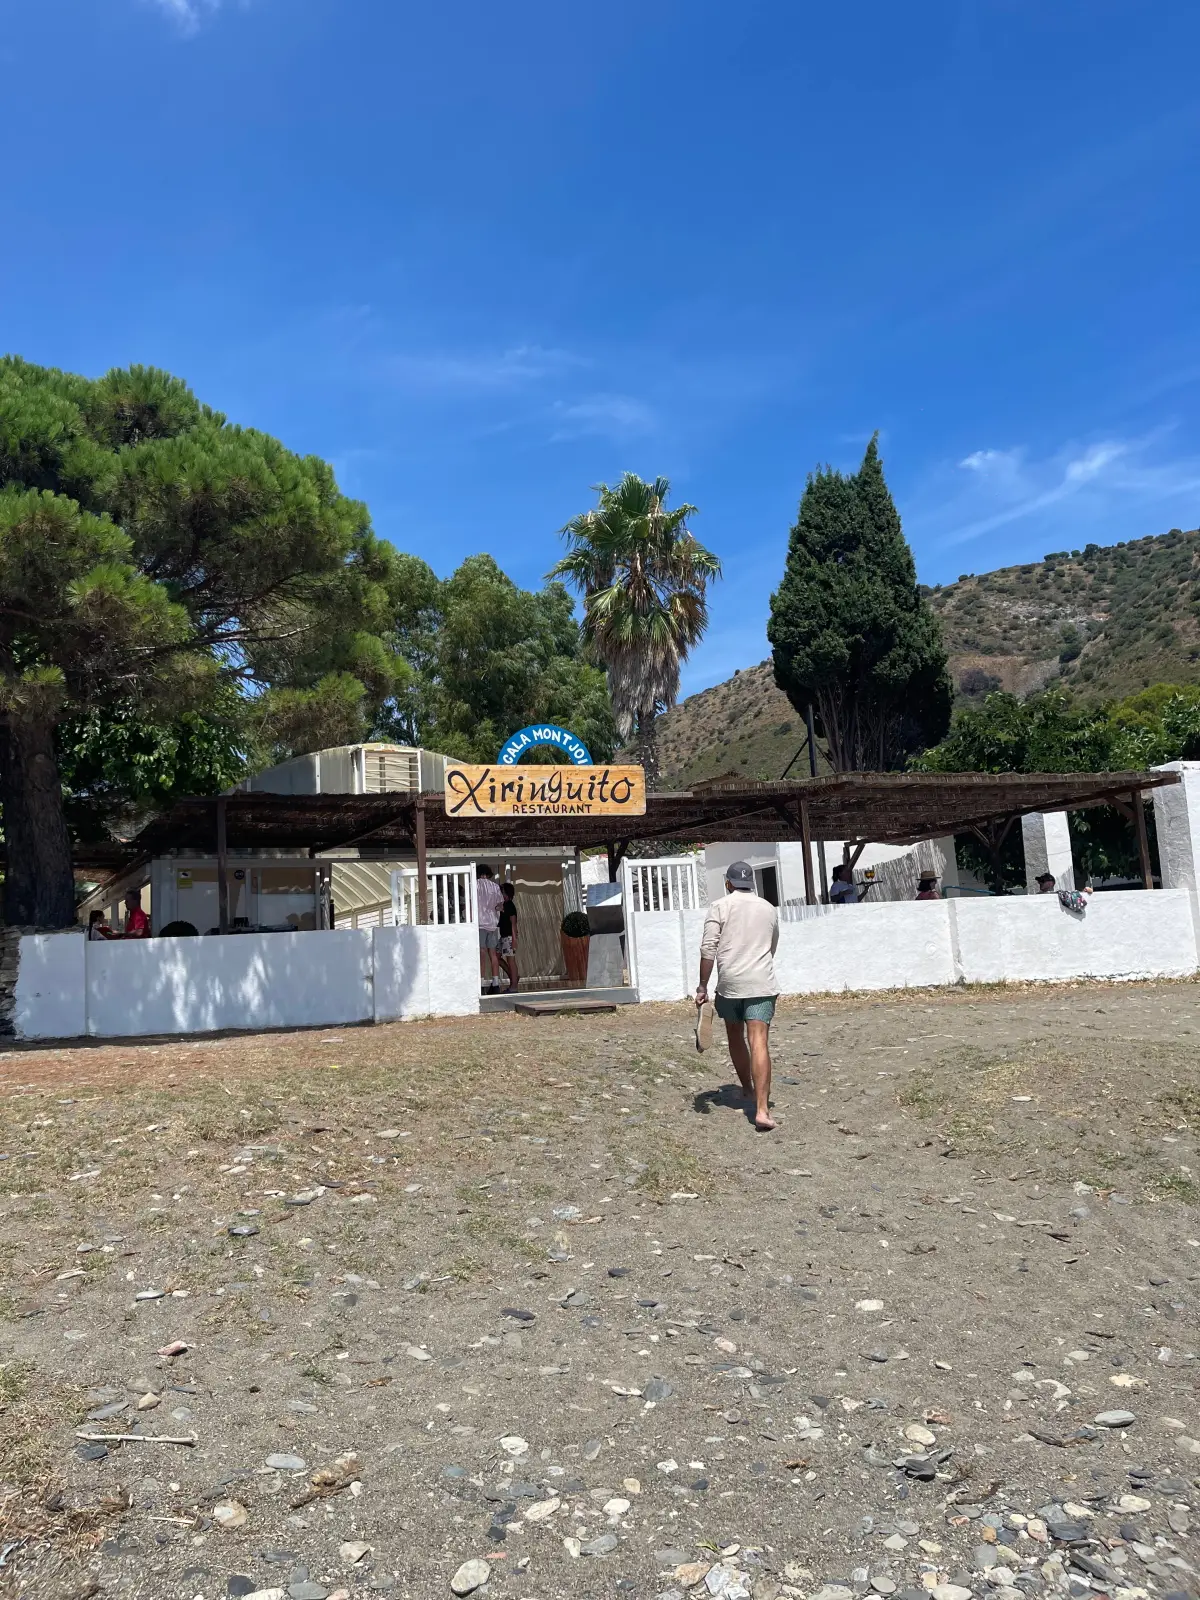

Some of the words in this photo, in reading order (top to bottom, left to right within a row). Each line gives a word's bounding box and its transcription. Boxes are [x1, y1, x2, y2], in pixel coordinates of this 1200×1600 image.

[502, 733, 532, 764] CALA
[447, 768, 635, 813] Xiringuito
[512, 804, 593, 814] RESTAURANT
